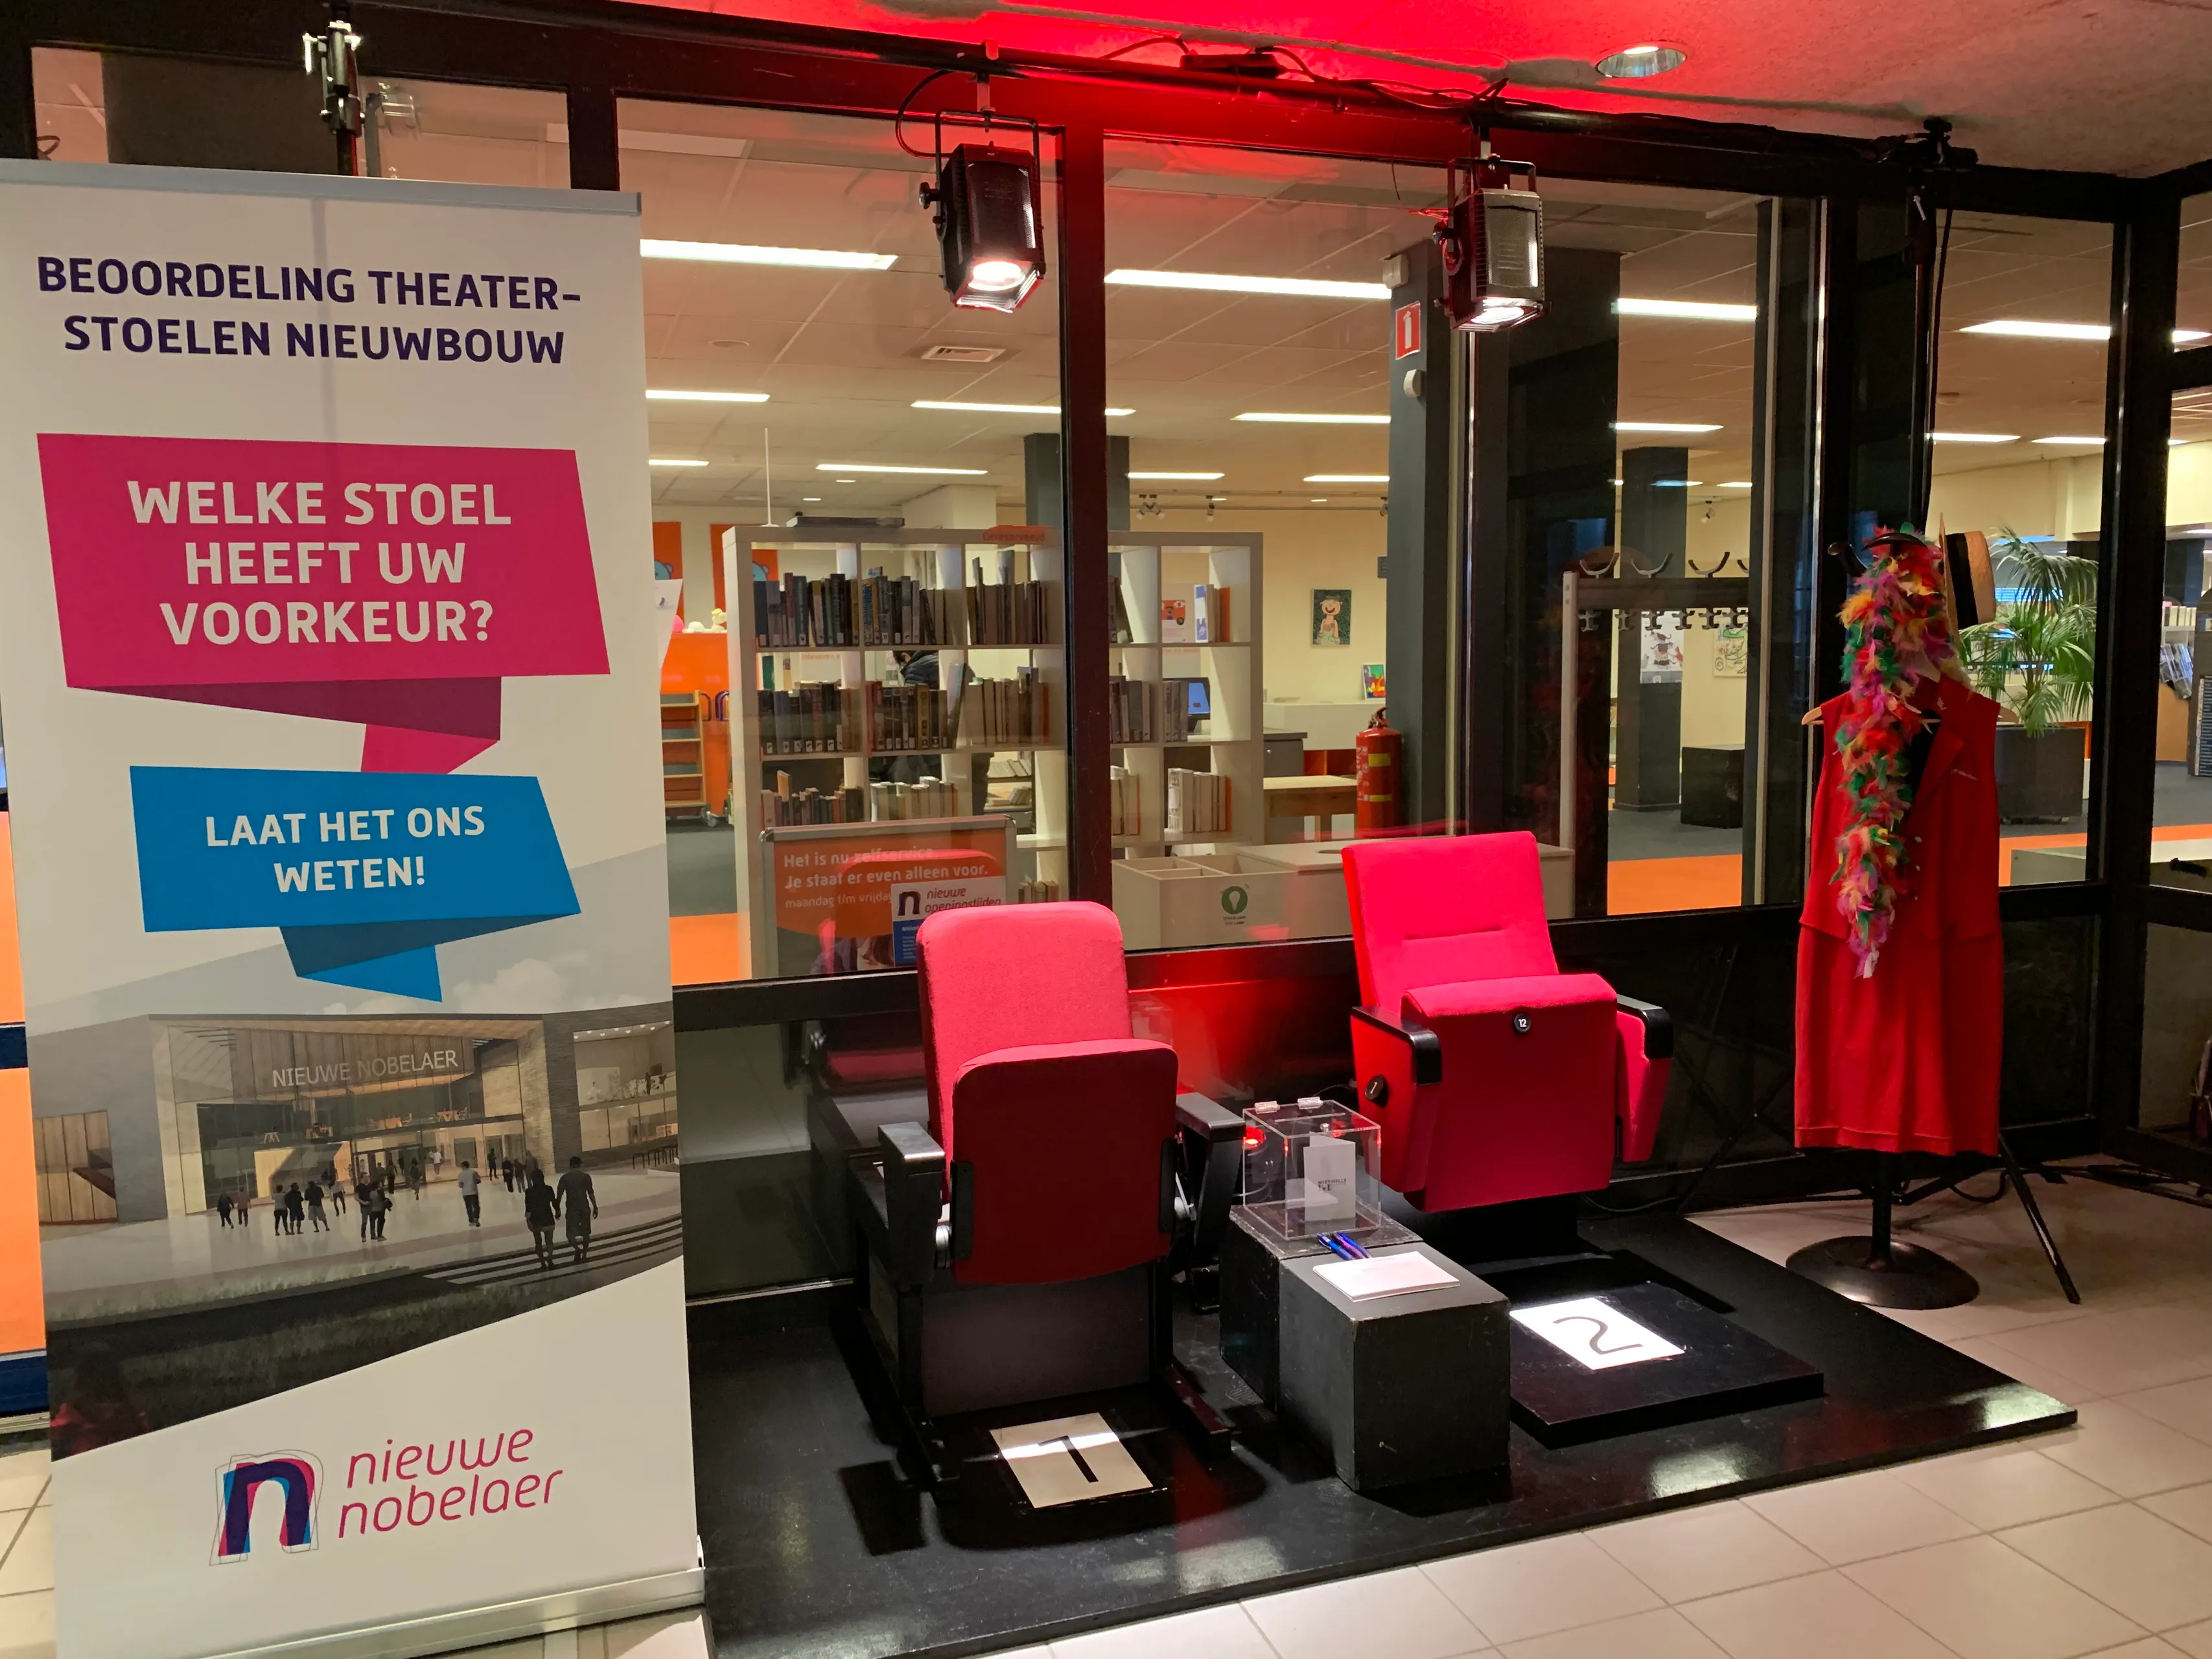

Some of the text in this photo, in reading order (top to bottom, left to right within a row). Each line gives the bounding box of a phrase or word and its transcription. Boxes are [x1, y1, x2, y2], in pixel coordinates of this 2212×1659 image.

[38, 256, 581, 310] BEOORDELING THEATER-
[64, 315, 564, 364] STOELEN NIEUWBOUW
[127, 481, 511, 525] WELKE STOEL
[185, 542, 465, 585] HEEFT UW
[159, 600, 493, 645] VOORKEUR?
[206, 806, 485, 846] LAAT HET ONS
[274, 856, 425, 892] WETEN!
[784, 853, 809, 868] Het
[814, 852, 827, 866] is
[830, 853, 850, 865] nu
[784, 864, 989, 890] Je staat er even alleen voor.
[785, 895, 835, 909] maandag
[837, 893, 856, 905] t/m
[926, 887, 966, 899] nieuwe
[1518, 1018, 1528, 1028] 12
[272, 1049, 459, 1088] NIEUWE NOBELAER
[1552, 1316, 1644, 1356] 2
[347, 1429, 533, 1489] nieuwe
[1037, 1435, 1099, 1483] 1
[338, 1470, 563, 1538] nobelaer
